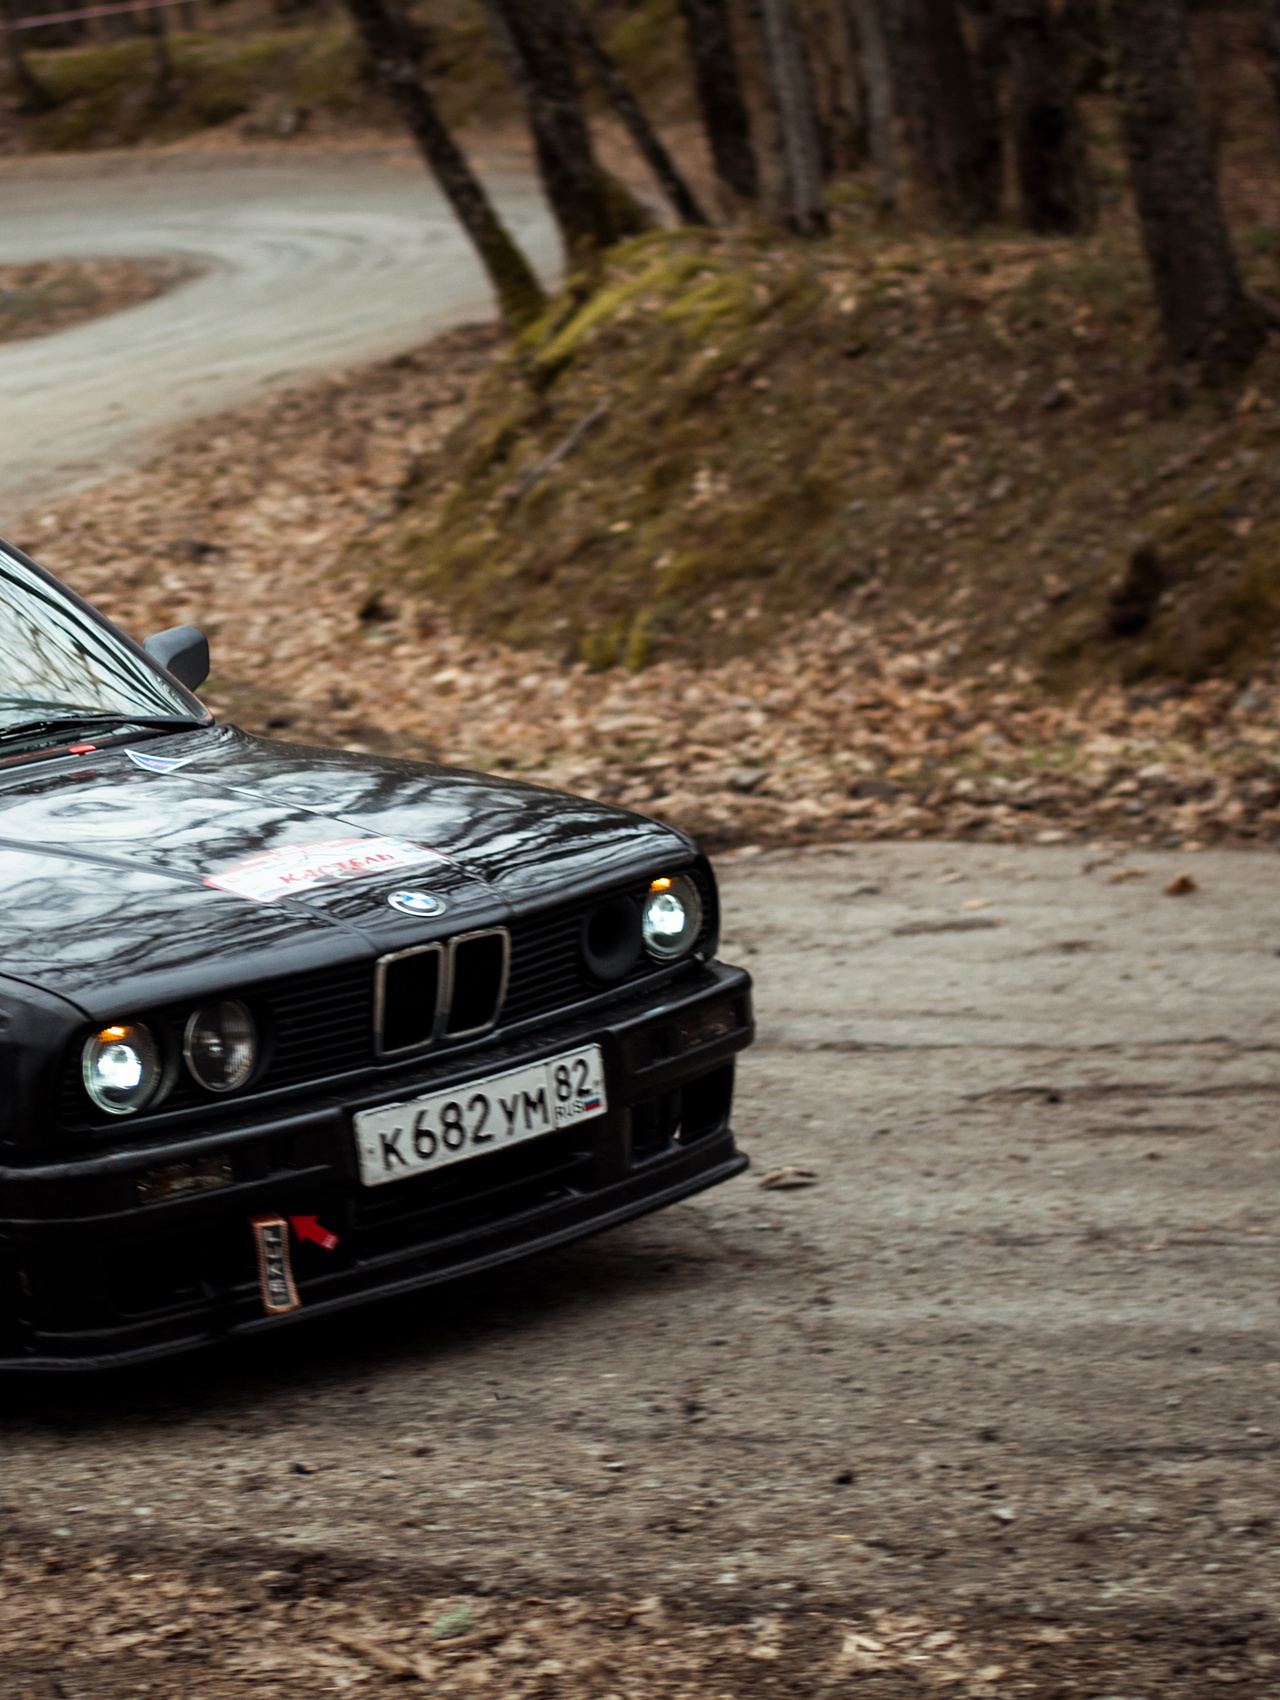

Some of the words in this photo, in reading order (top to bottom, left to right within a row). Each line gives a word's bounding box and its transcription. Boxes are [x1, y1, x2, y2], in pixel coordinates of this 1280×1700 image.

[279, 852, 395, 885] КАСТЕЛЬ
[378, 1086, 552, 1172] К682УМ
[553, 1058, 594, 1103] 82
[555, 1099, 585, 1121] RUS
